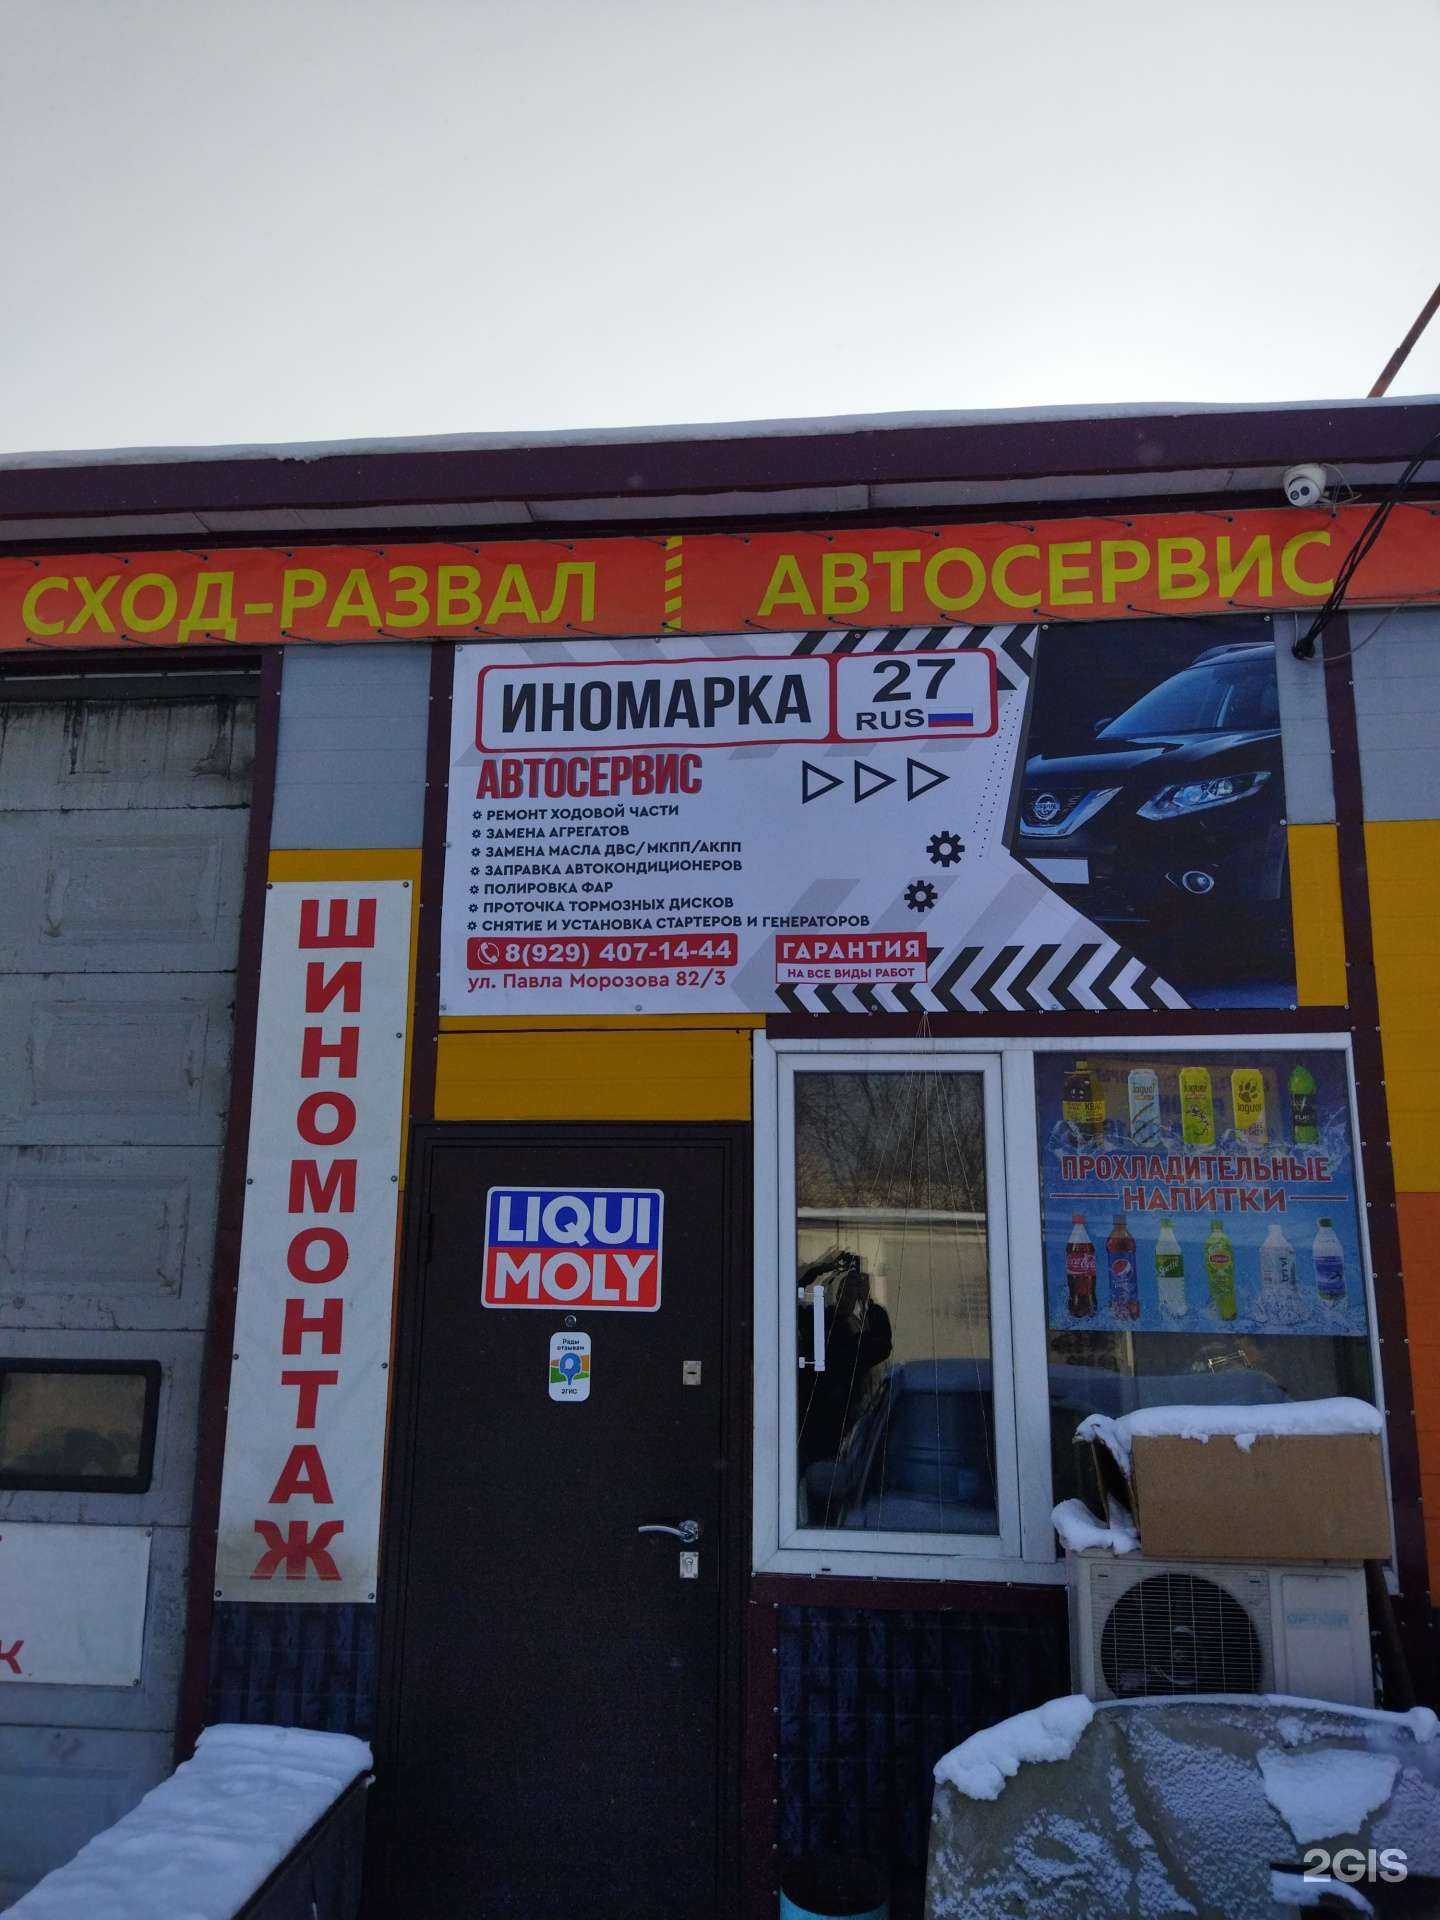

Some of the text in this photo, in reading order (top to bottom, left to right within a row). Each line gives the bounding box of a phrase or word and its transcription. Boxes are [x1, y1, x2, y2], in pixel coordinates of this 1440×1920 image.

[758, 531, 1335, 616] АВТОСЕРВИС
[21, 561, 597, 643] СХОД-РАЗВАЛ
[872, 658, 955, 702] 27
[502, 674, 811, 733] ИНОМАРКА
[856, 708, 925, 730] RUS
[476, 753, 703, 799] АВТОСЕРВИС
[487, 804, 679, 821] РЕМОНТ ХОДОВОЙ ЧАСТИ
[486, 825, 629, 839] ЗАМЕНА АГРЕГАТОВ
[486, 846, 545, 857] ЗАМЕНА
[549, 844, 601, 856] МАСЛА
[484, 860, 742, 876] ЗАПРАВКА АВТОКОНДИЦИОНЕРОВ
[484, 881, 613, 895] ПОЛИРОВКА ФАР
[483, 897, 734, 913] ПРОТОЧКА ТОРМОЗНЫХ ДИСКОВ
[482, 915, 869, 932] СНЯТИЕ И УСТАНОВКА СТАРТЕРОВ И ГЕНЕРАТОРОВ
[504, 940, 731, 966] 8(929) 407-14-44
[783, 939, 920, 960] ГАРАНТИЯ
[468, 968, 726, 992] ул. Павла Морозова 82/3
[788, 967, 915, 979] НА ВСЕ ВИДЫ РАБОТ
[1061, 1154, 1332, 1184] ПРОХЛАДИТЕЛЬНЫЕ
[1122, 1186, 1287, 1212] НАПИТКИ
[498, 1195, 651, 1247] LIQUI
[252, 898, 377, 1581] ШИНОМОНТАЖ
[494, 1251, 656, 1302] MOLY
